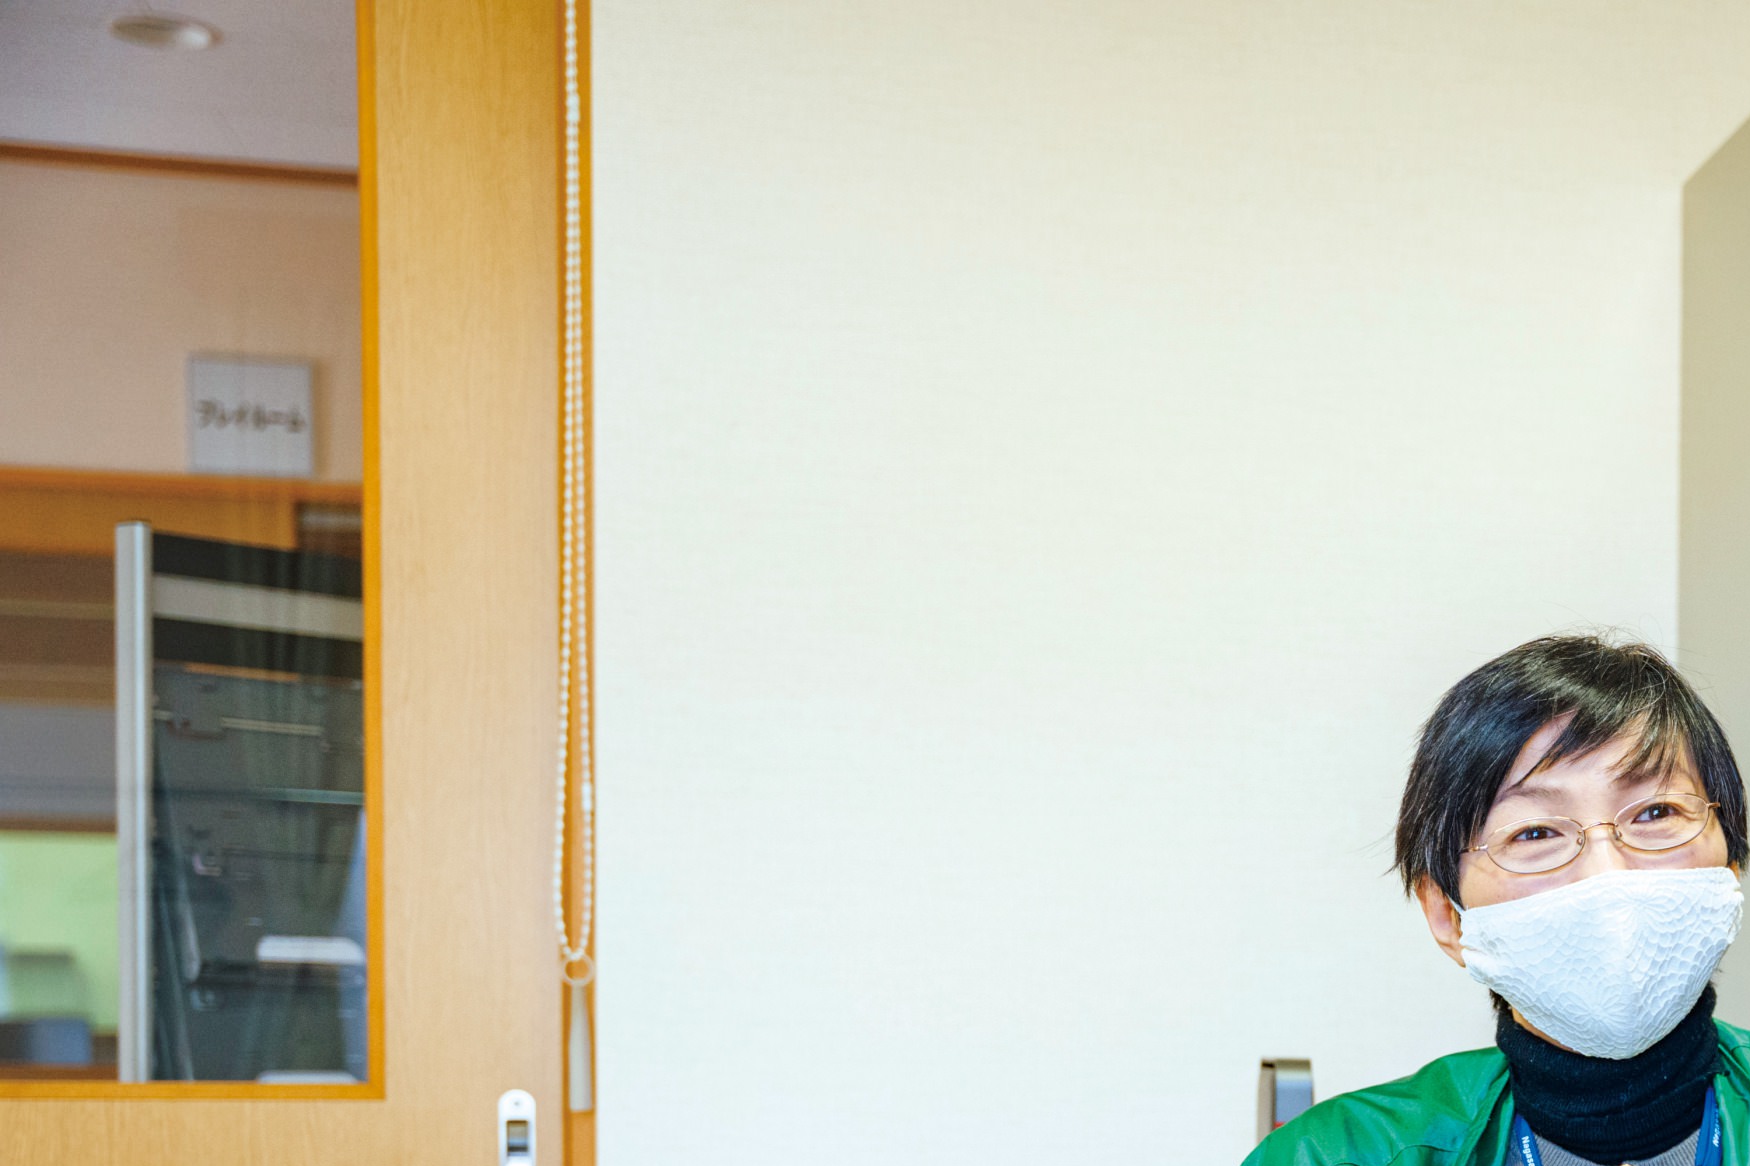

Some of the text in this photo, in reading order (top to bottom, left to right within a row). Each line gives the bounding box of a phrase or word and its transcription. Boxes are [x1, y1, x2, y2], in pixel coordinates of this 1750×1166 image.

[196, 399, 307, 434] プレイルーム
